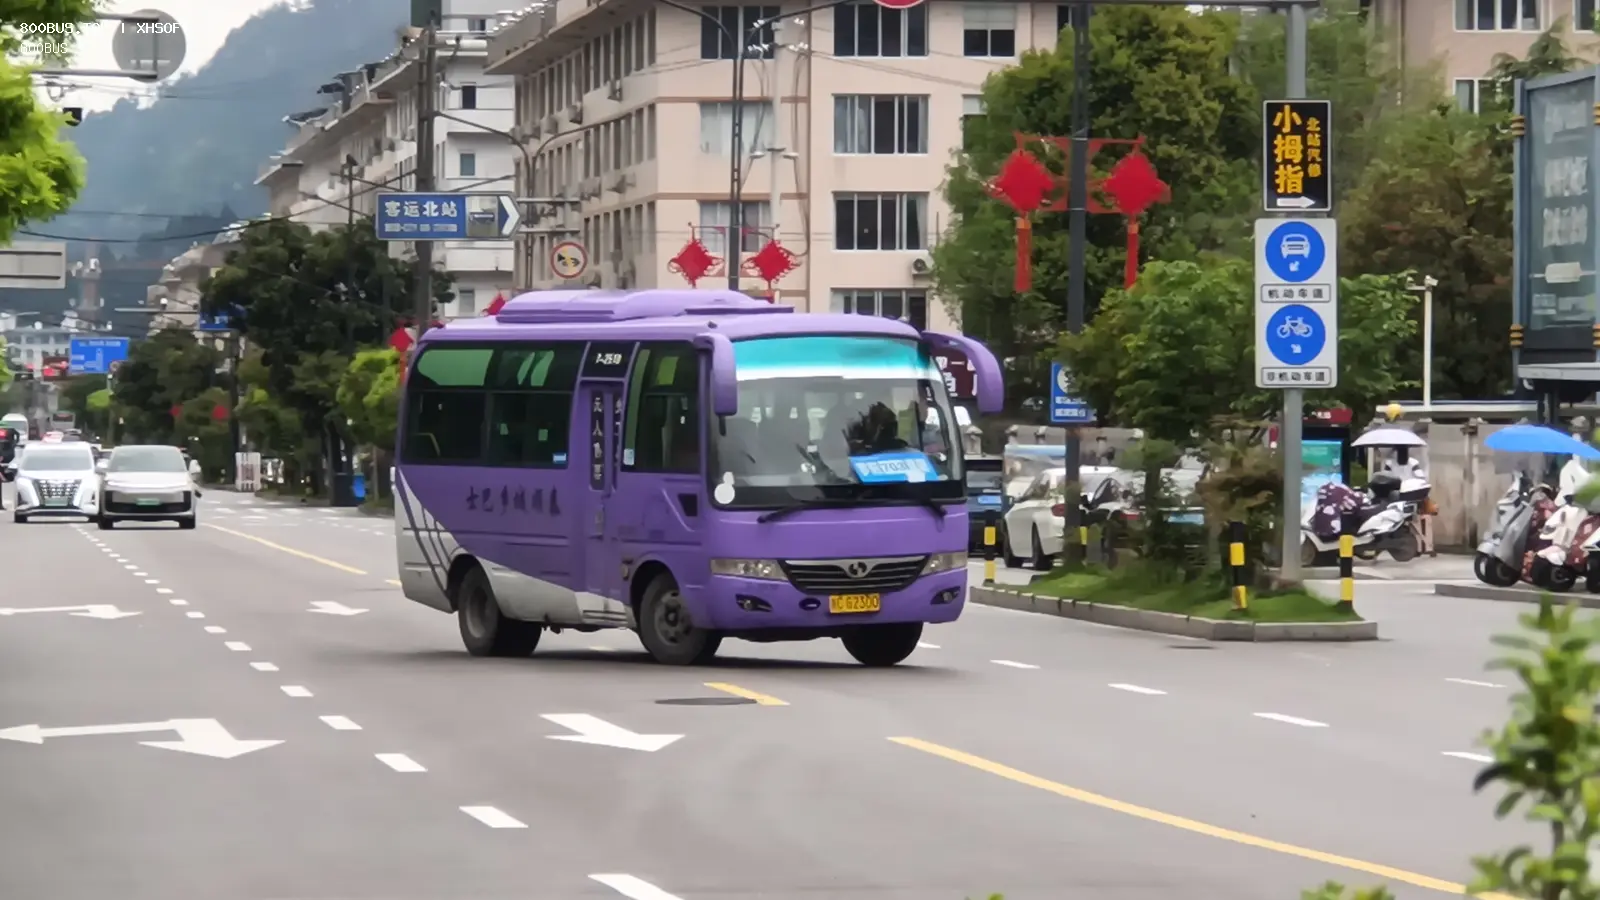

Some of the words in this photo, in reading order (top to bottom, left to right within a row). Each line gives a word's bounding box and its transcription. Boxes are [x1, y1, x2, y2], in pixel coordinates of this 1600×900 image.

[1273, 105, 1303, 193] 小拇指
[384, 201, 457, 217] 客运北站
[1268, 288, 1323, 298] 机动车道
[1267, 372, 1325, 381] 非机动车道
